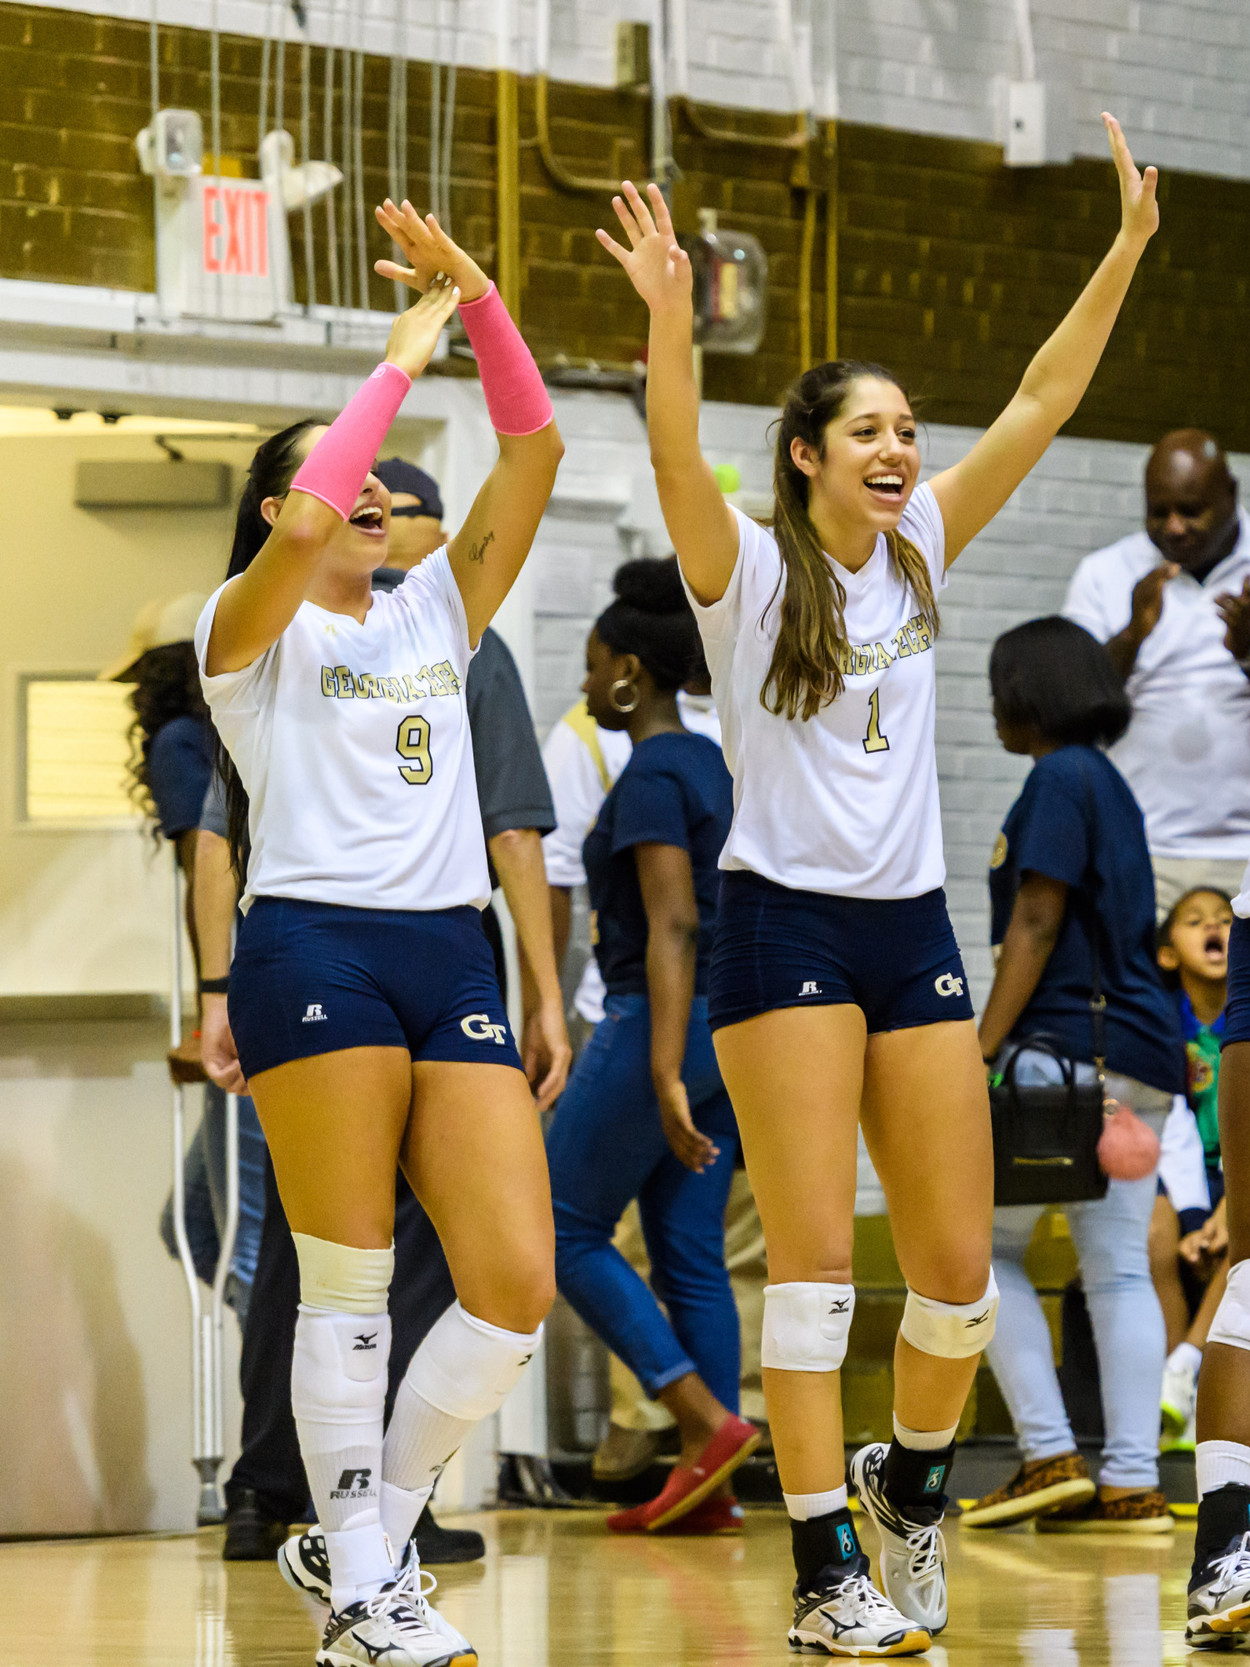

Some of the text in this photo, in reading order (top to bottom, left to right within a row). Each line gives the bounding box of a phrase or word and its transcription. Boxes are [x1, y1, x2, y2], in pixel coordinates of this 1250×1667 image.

[203, 186, 270, 278] EXIT
[321, 665, 427, 703] GEORGIA
[862, 687, 890, 754] 1
[396, 715, 433, 785] 9
[935, 972, 964, 997] GT
[460, 1014, 507, 1045] GT
[329, 1487, 378, 1500] RUSSELL
